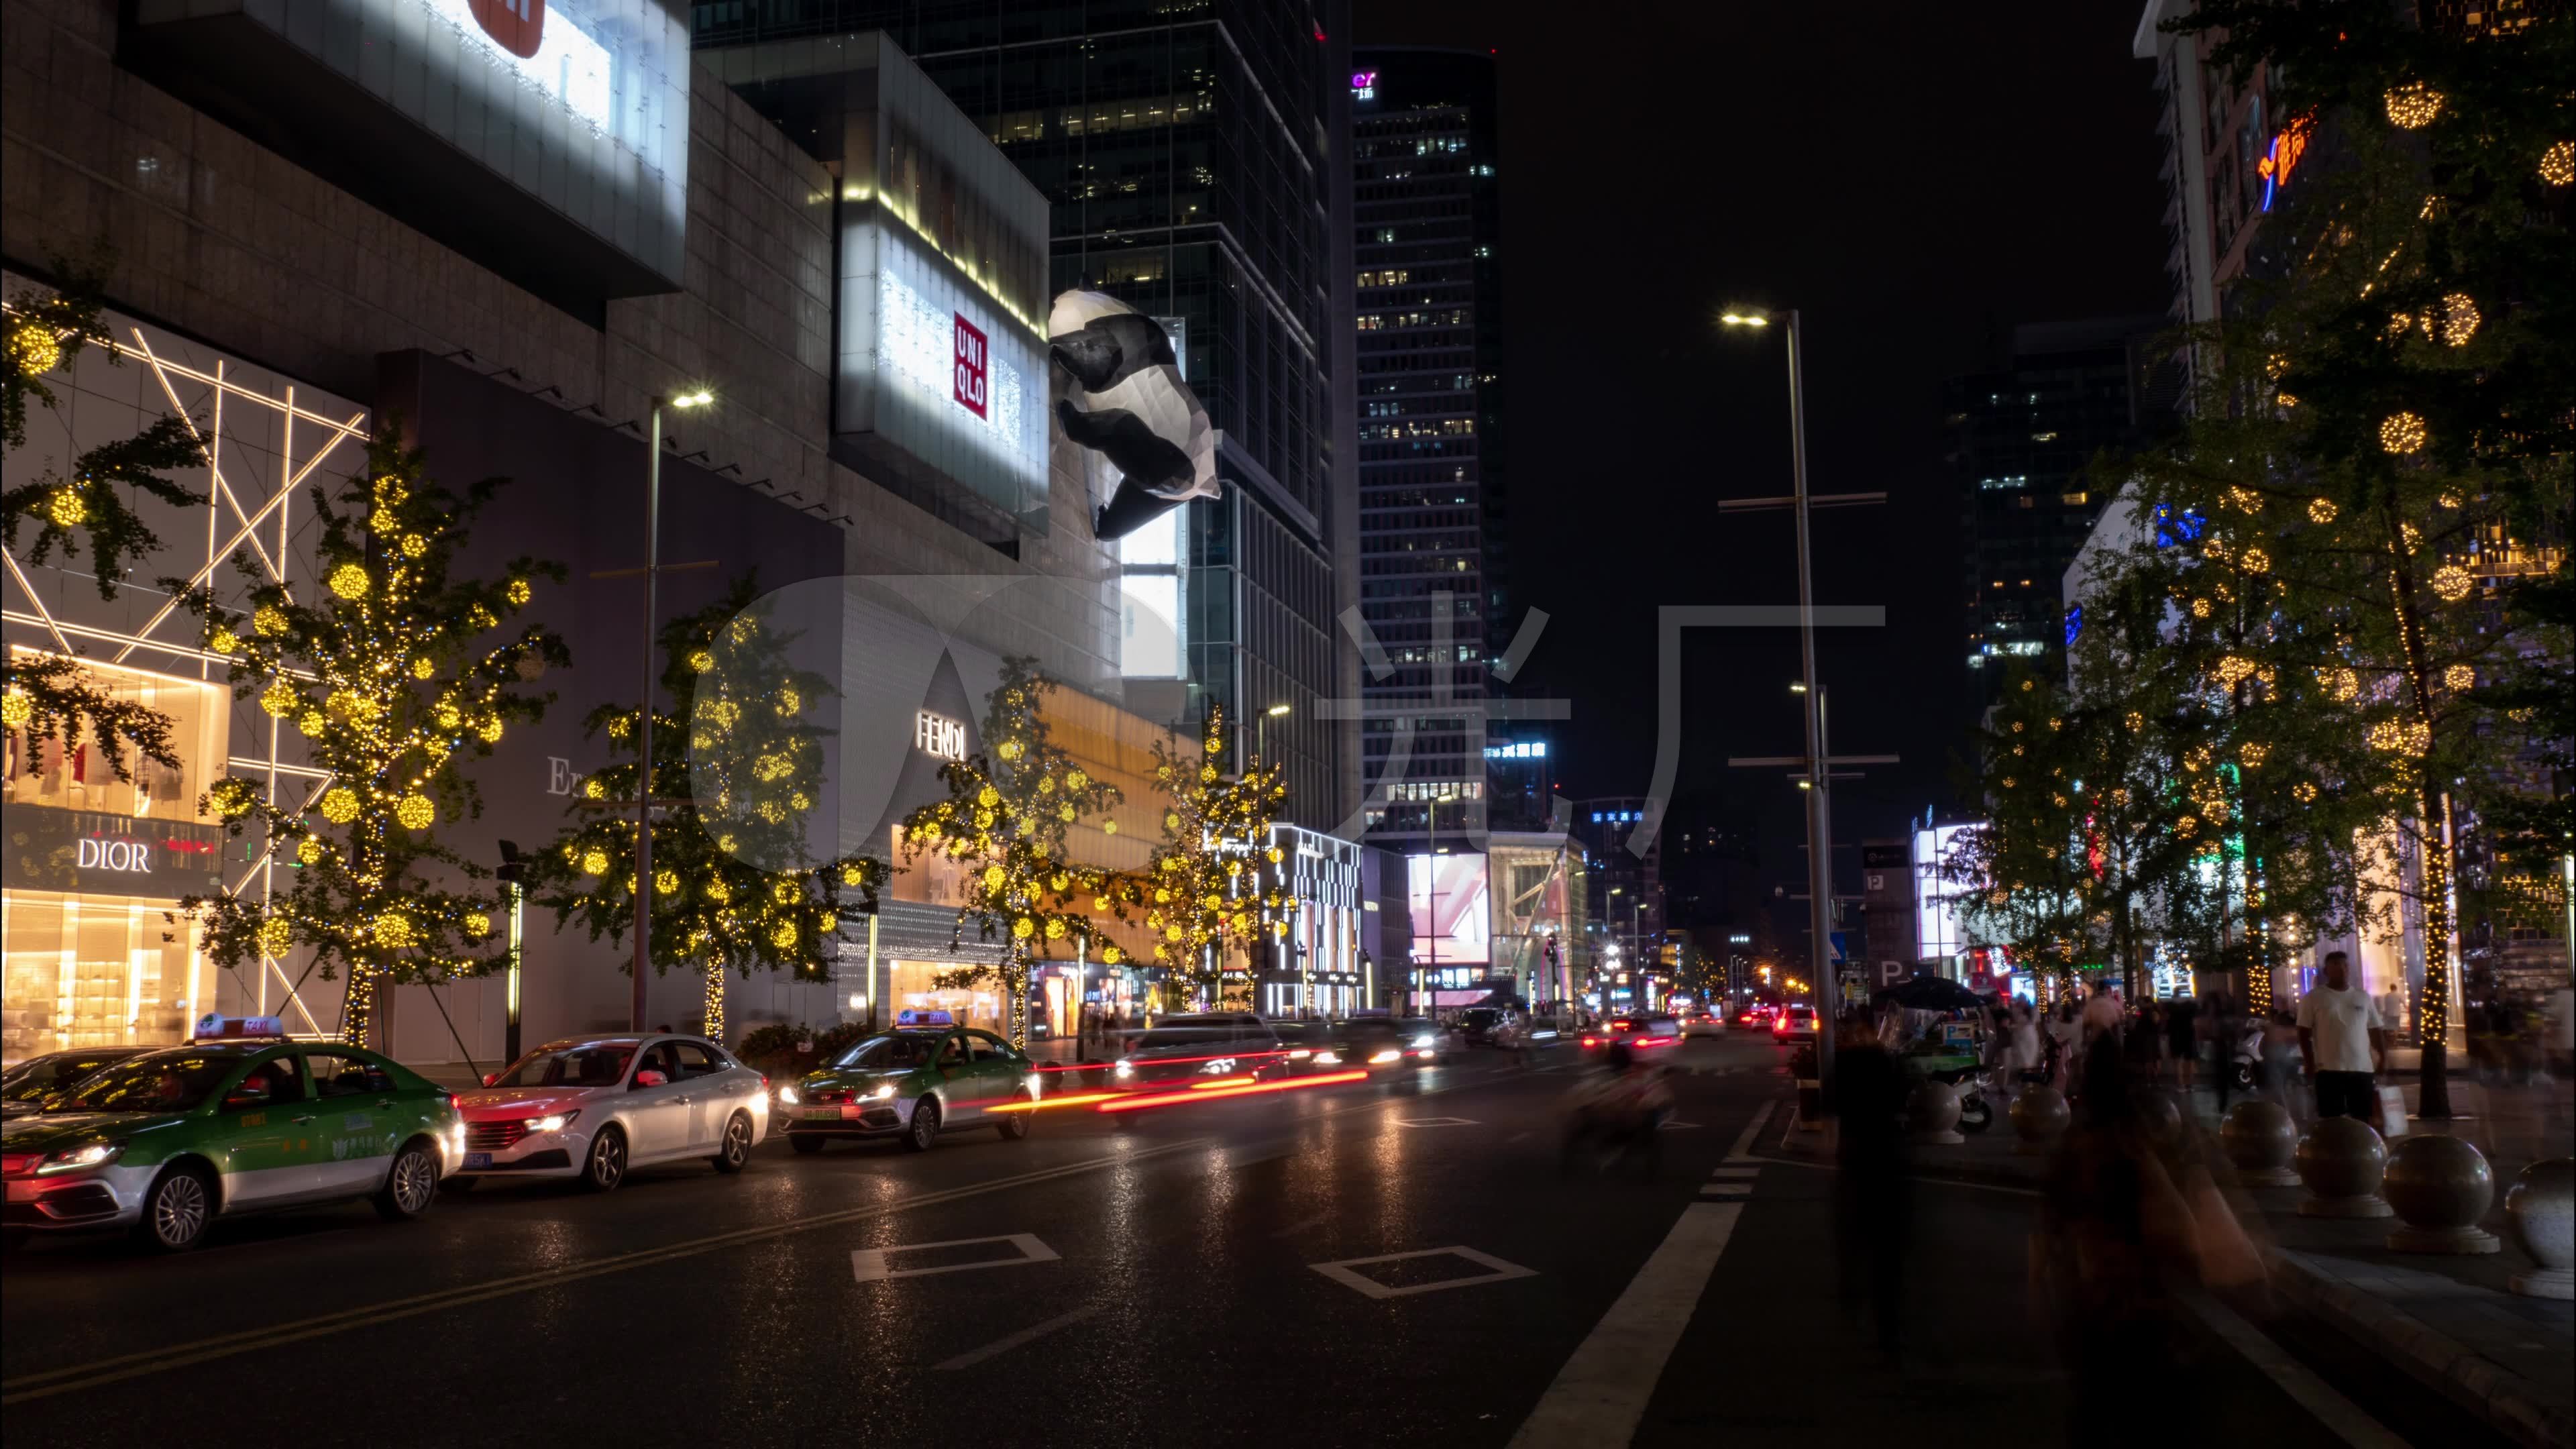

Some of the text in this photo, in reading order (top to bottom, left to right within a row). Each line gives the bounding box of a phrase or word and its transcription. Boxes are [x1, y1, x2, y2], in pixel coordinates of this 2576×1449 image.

[957, 325, 982, 371] UNI
[957, 363, 984, 407] QLO
[916, 711, 965, 761] FENDI
[78, 839, 151, 873] DIOR
[1882, 961, 1903, 987] P
[246, 1020, 268, 1032] TAXI
[930, 1012, 945, 1021] TAXI
